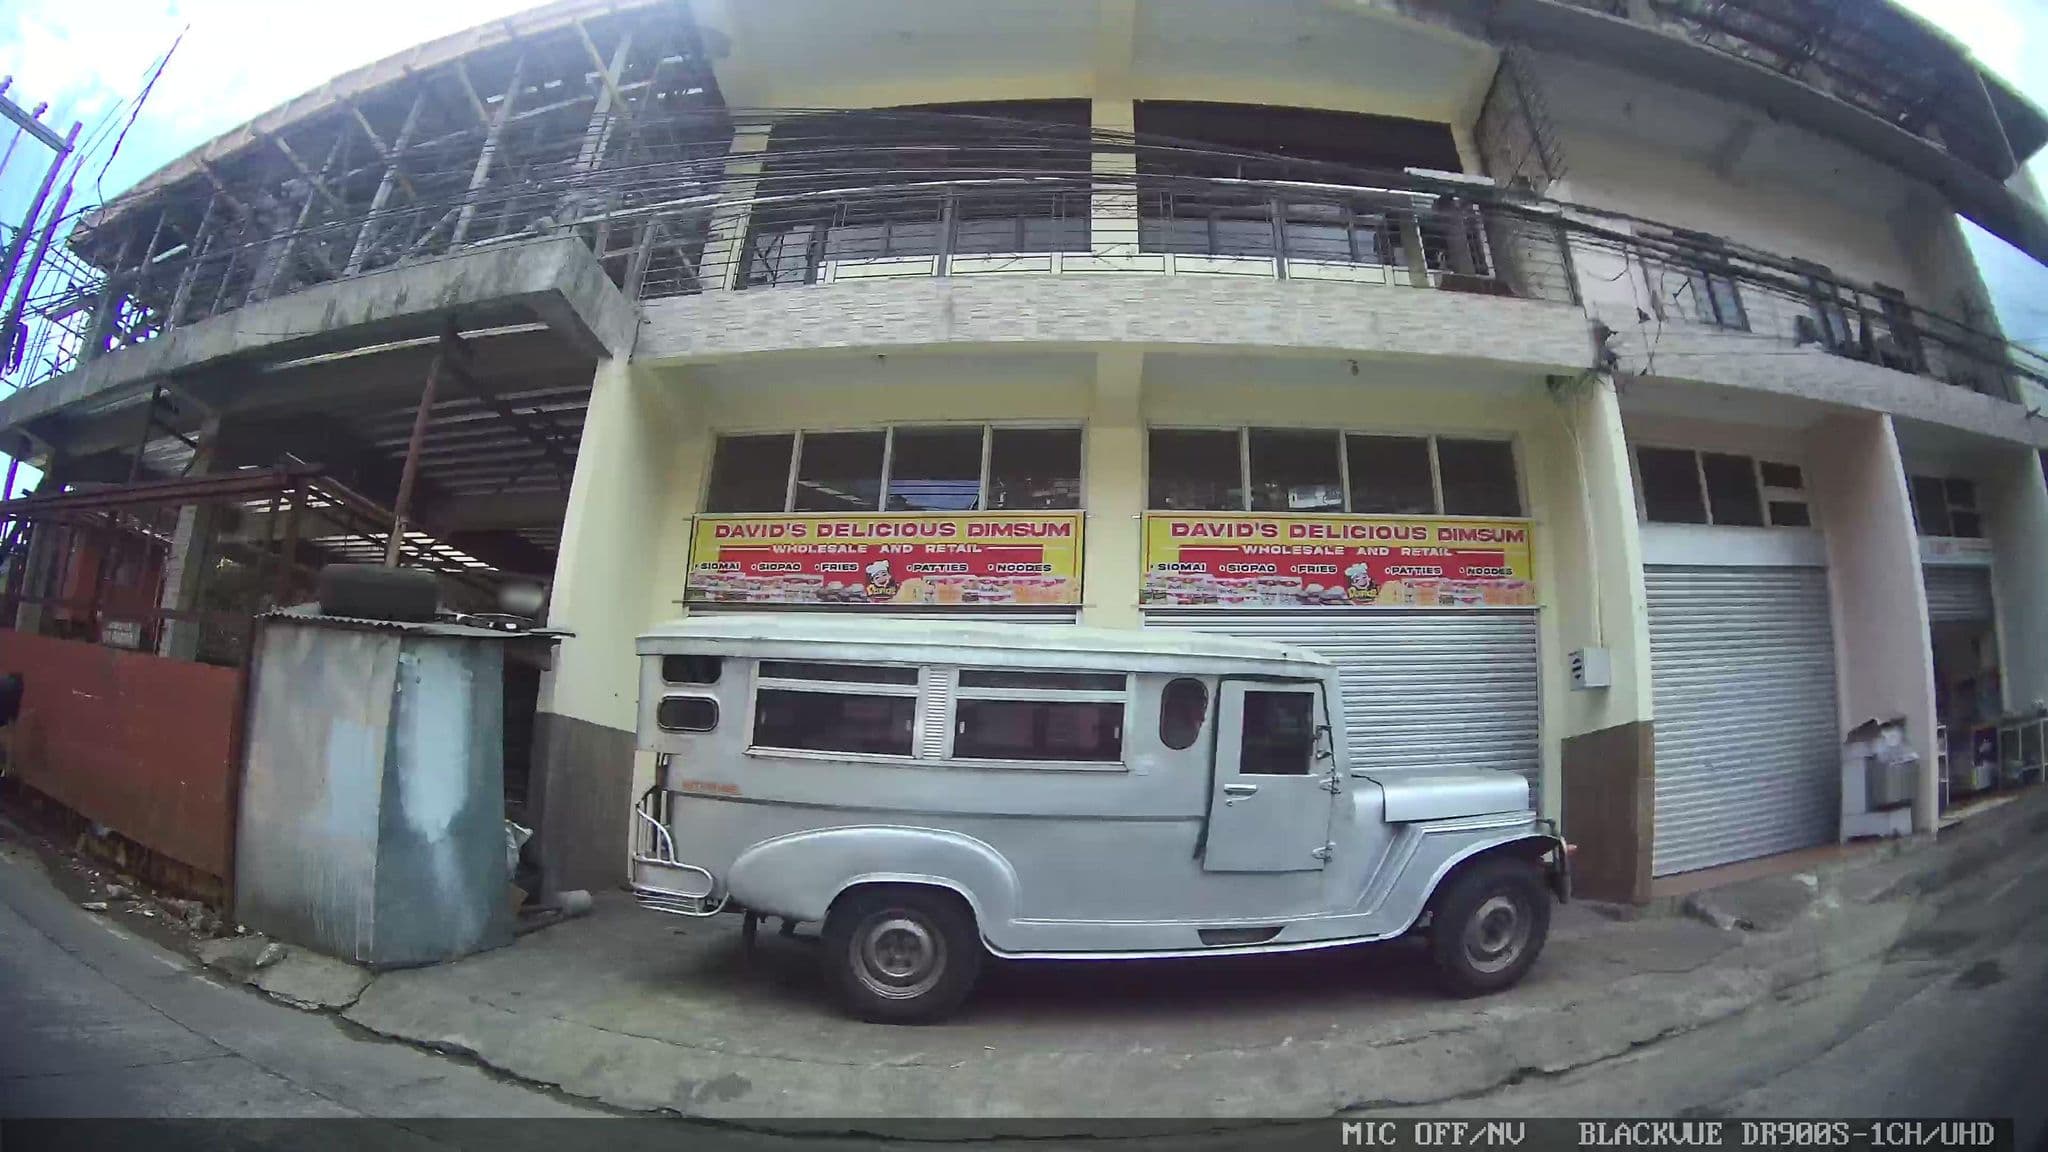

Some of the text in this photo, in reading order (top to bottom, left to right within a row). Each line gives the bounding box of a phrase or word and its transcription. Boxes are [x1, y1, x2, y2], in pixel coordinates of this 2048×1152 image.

[715, 522, 1072, 538] DAVID'S DELICIOUS DIMSUM
[1171, 522, 1525, 543] DAVID'S DELICIOUS DIMSUM
[772, 543, 983, 555] WHOLESALE AND RETAIL
[1241, 544, 1452, 557] WHOLESALE AND RETAIL
[699, 562, 741, 572] SIOMAI
[758, 562, 801, 571] SIOPAO
[821, 562, 859, 571] FRIES
[912, 562, 969, 572] PATTIES
[1157, 562, 1207, 572] SIOMAI
[1226, 563, 1277, 574] SIOPAO
[1297, 564, 1337, 574] FRIES
[1390, 565, 1443, 576] PATTIES
